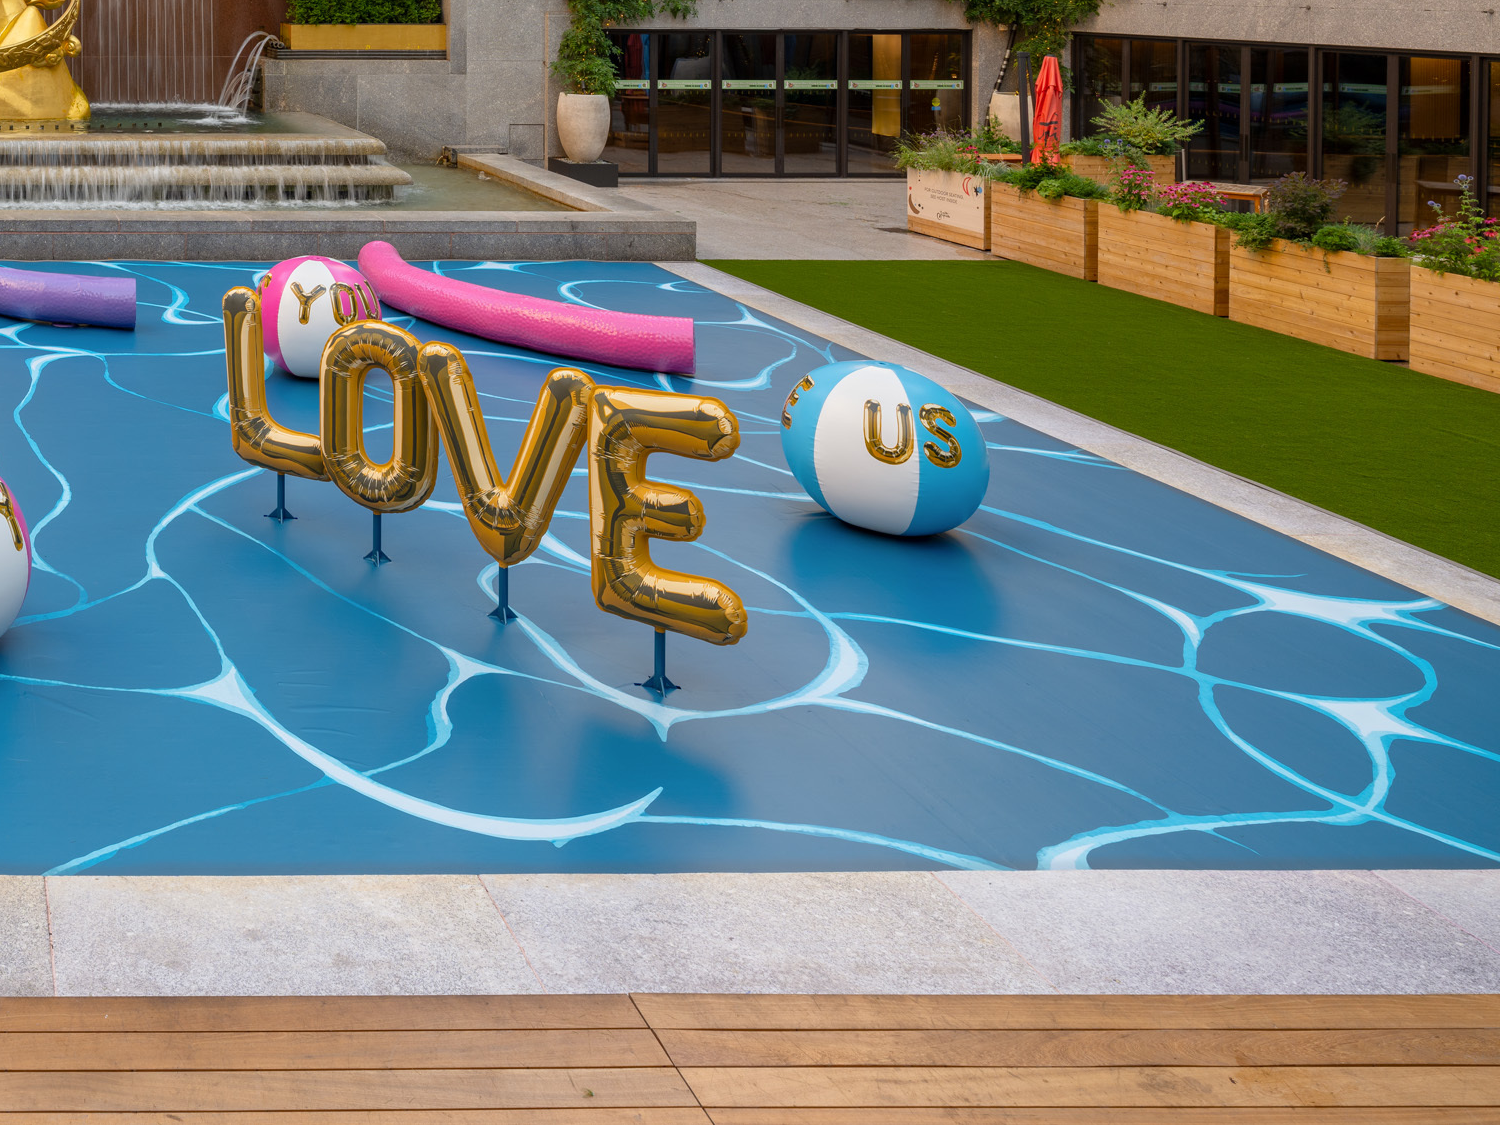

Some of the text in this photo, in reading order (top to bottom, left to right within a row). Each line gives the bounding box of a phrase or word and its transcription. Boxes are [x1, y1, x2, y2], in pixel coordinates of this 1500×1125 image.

[290, 280, 380, 327] YOU
[222, 285, 749, 646] LOVE
[862, 397, 963, 469] US
